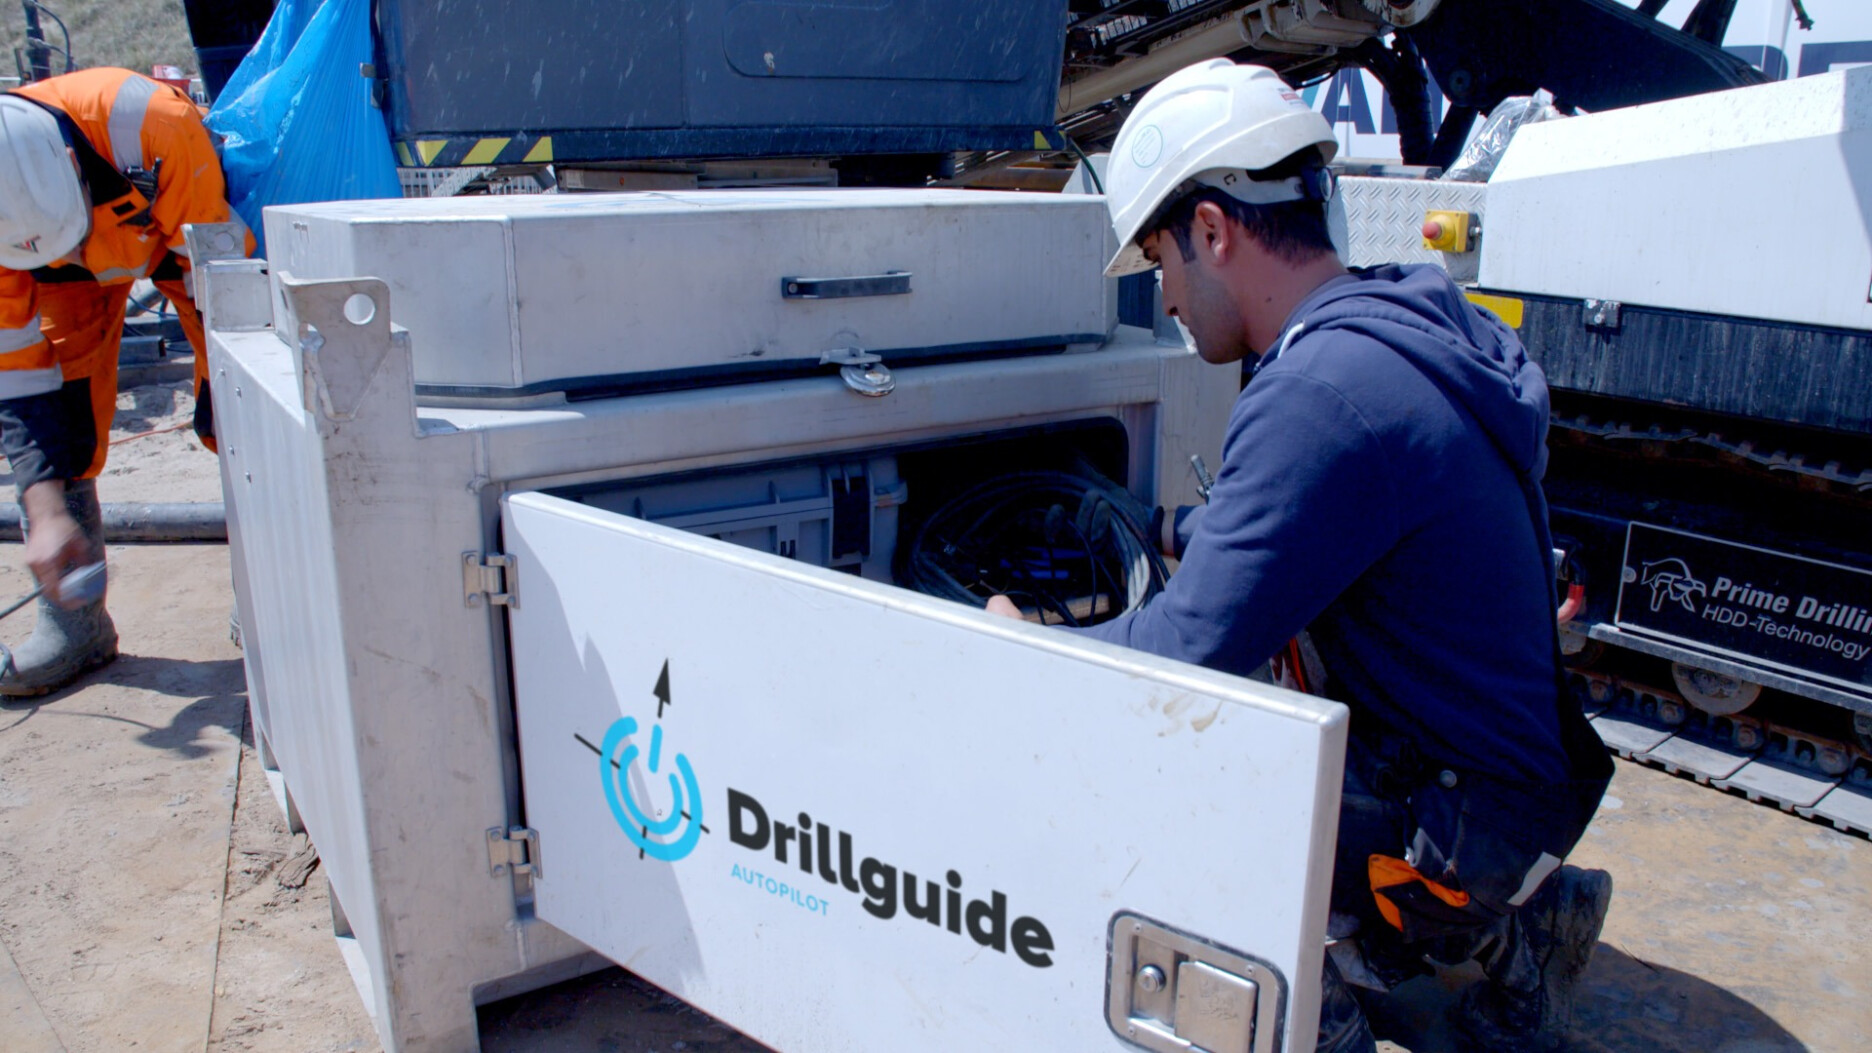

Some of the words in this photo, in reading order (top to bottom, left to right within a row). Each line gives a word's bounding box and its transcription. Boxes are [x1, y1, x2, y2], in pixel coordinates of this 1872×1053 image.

[1711, 576, 1790, 613] Prime
[1702, 603, 1871, 661] HDD-Technology
[727, 787, 1055, 968] Drillguide
[731, 863, 829, 916] AUTOPILOT
